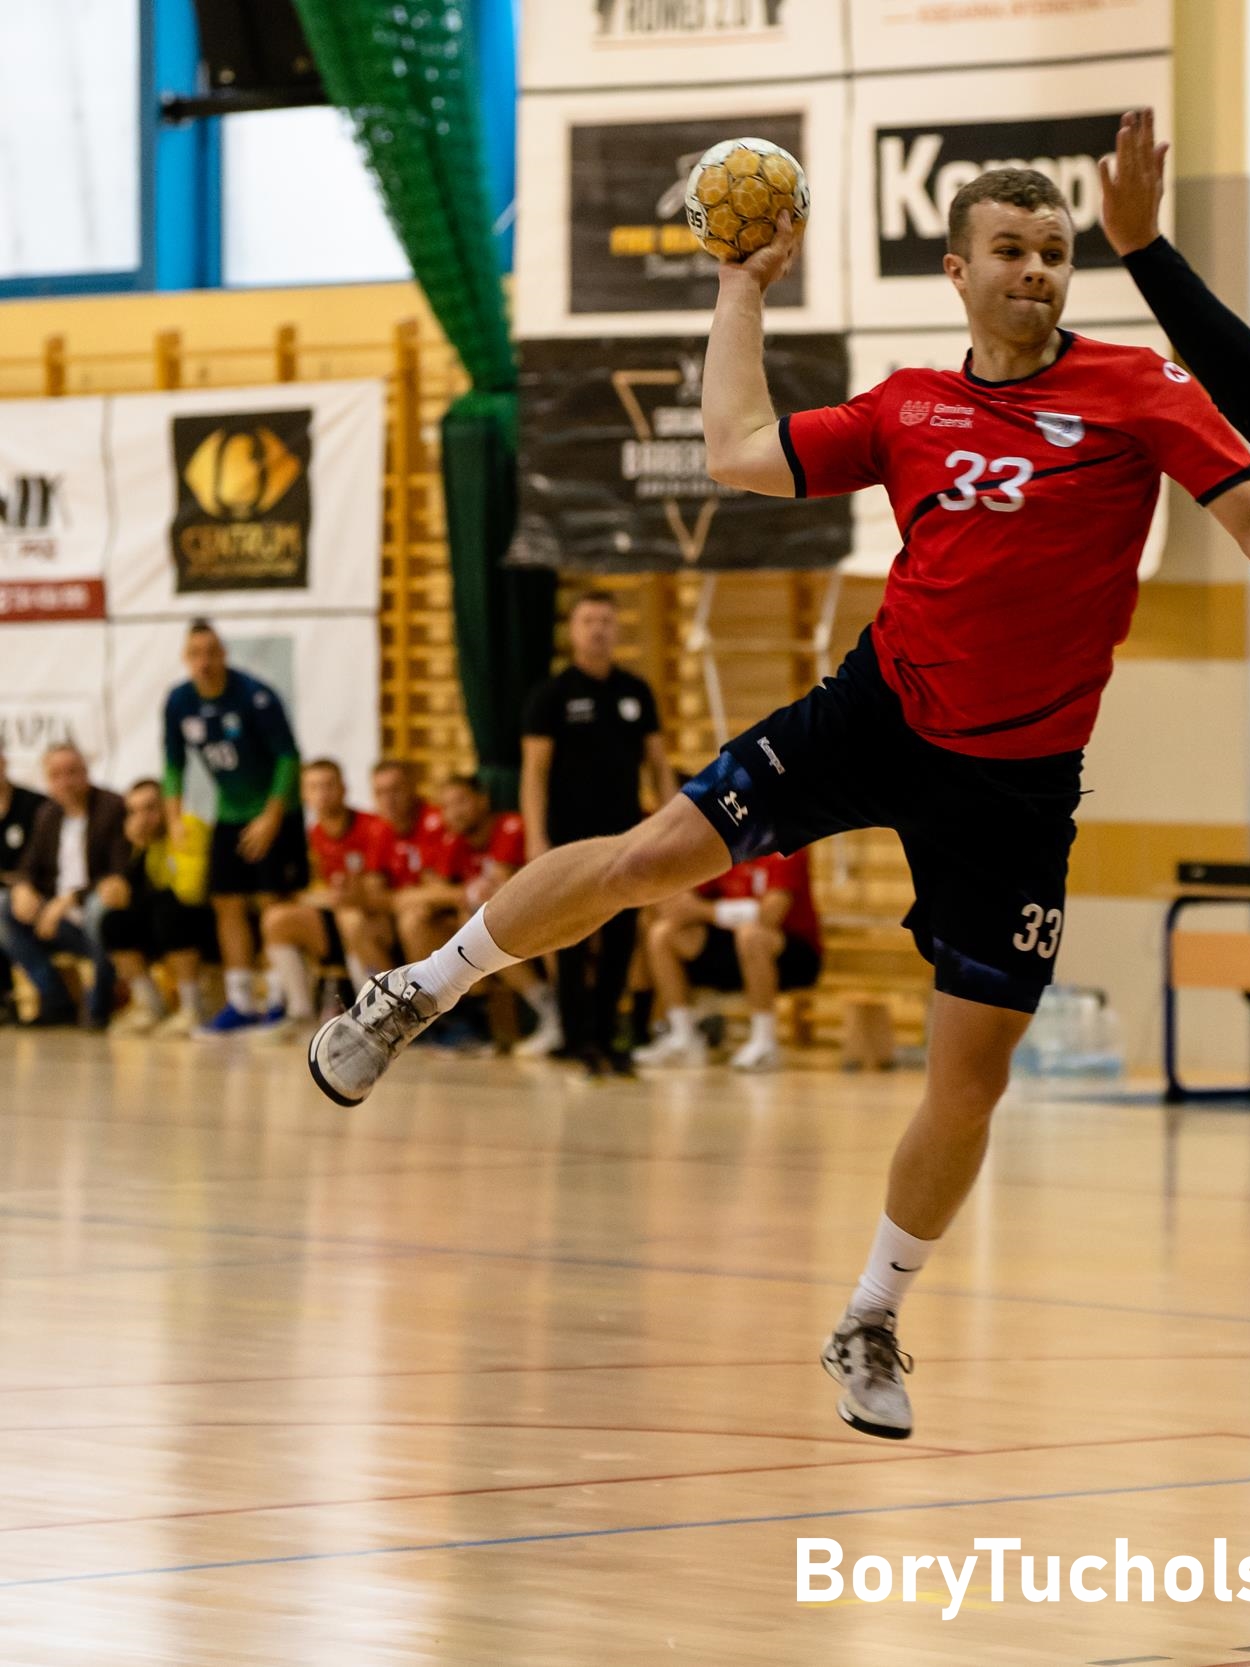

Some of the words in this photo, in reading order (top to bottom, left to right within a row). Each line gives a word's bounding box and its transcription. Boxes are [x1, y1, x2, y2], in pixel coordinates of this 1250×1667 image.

[880, 133, 1117, 240] Kep
[936, 450, 1034, 513] 33
[1012, 903, 1063, 959] 33
